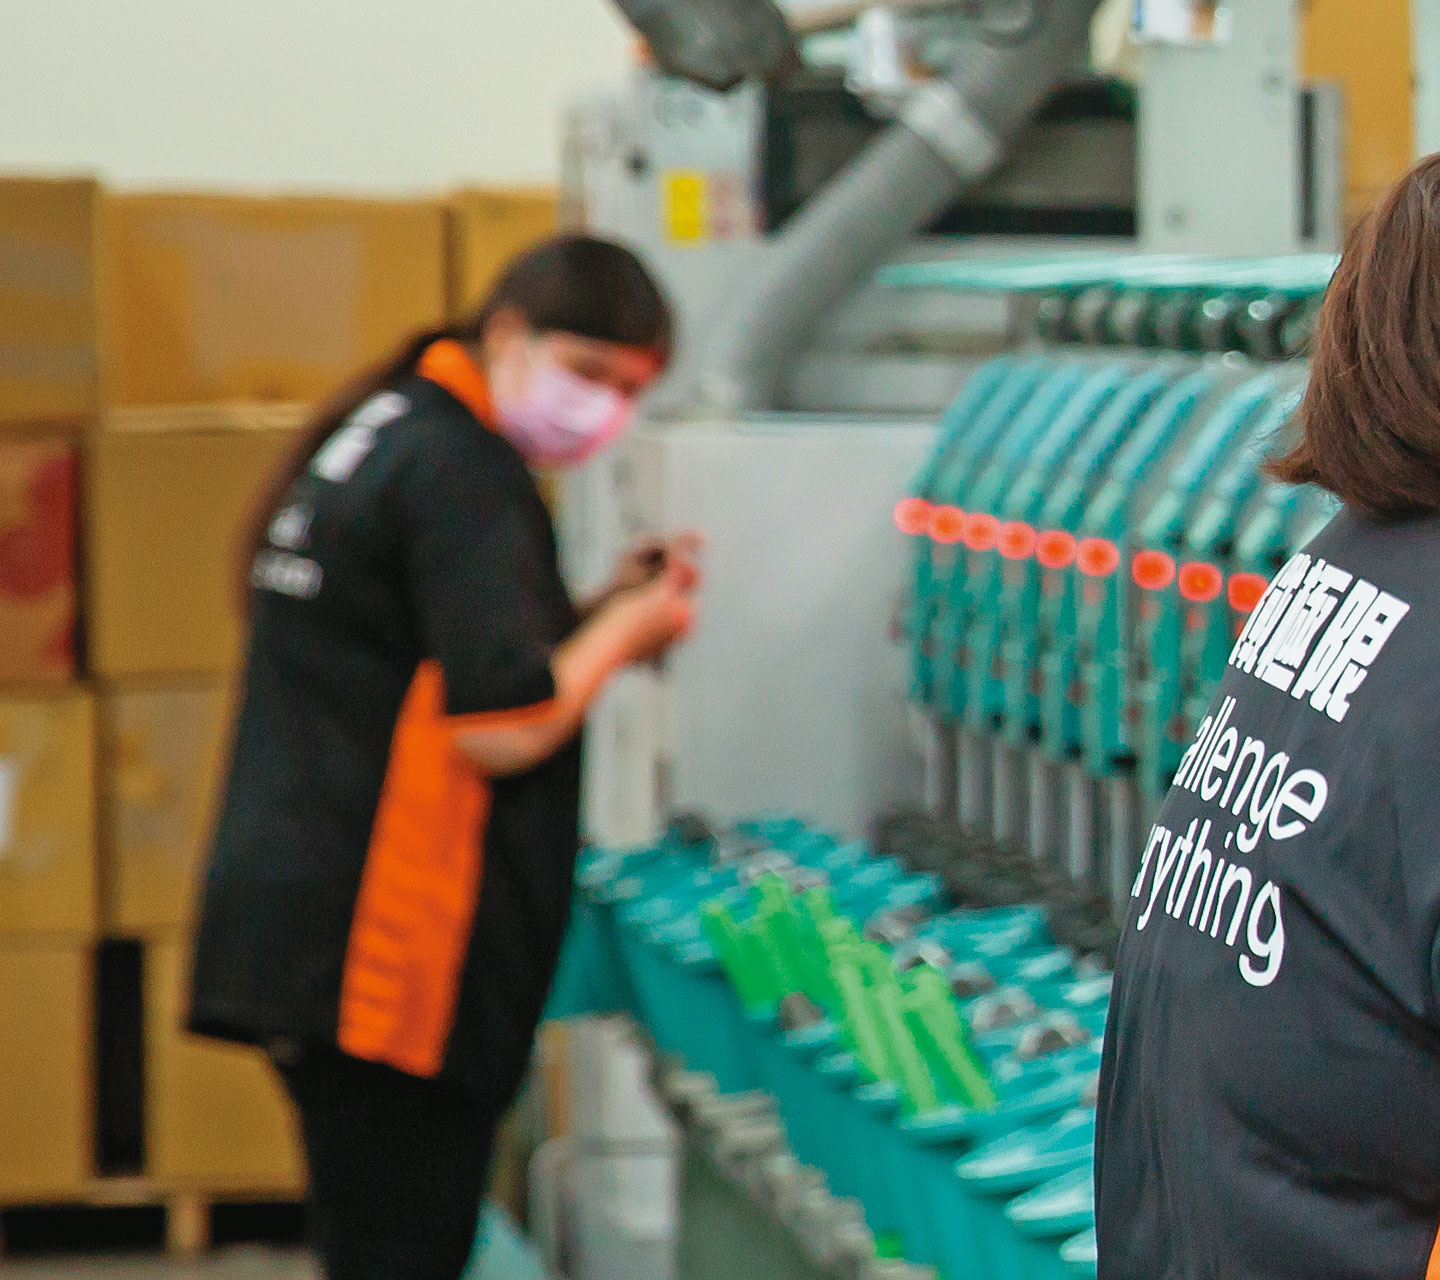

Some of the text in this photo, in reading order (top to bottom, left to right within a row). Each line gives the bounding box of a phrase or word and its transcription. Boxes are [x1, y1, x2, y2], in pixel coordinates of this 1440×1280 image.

[1228, 552, 1411, 723] 戰極限
[1172, 694, 1329, 854] allenge
[1130, 817, 1286, 988] rything
